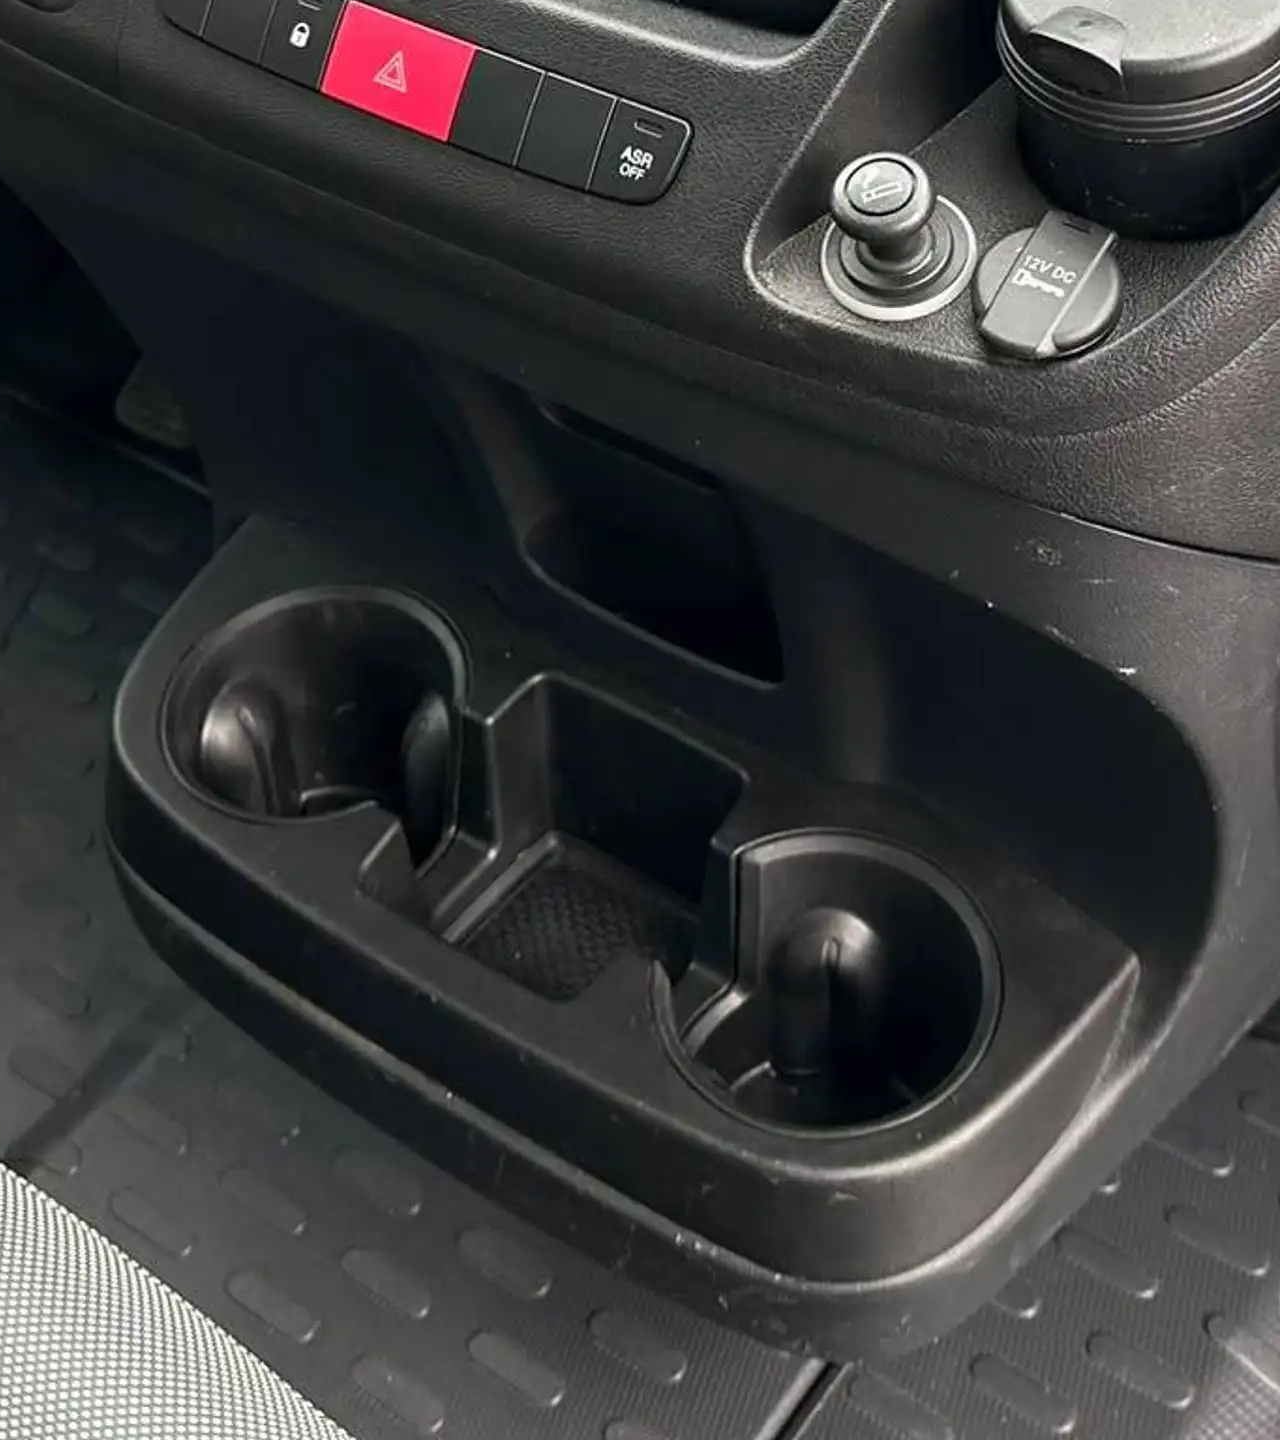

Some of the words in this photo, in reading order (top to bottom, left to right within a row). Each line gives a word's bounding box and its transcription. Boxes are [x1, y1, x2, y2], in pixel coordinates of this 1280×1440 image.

[621, 145, 654, 170] ASR
[619, 162, 646, 181] OFF
[1023, 255, 1054, 273] 12V
[1051, 266, 1077, 284] DC
